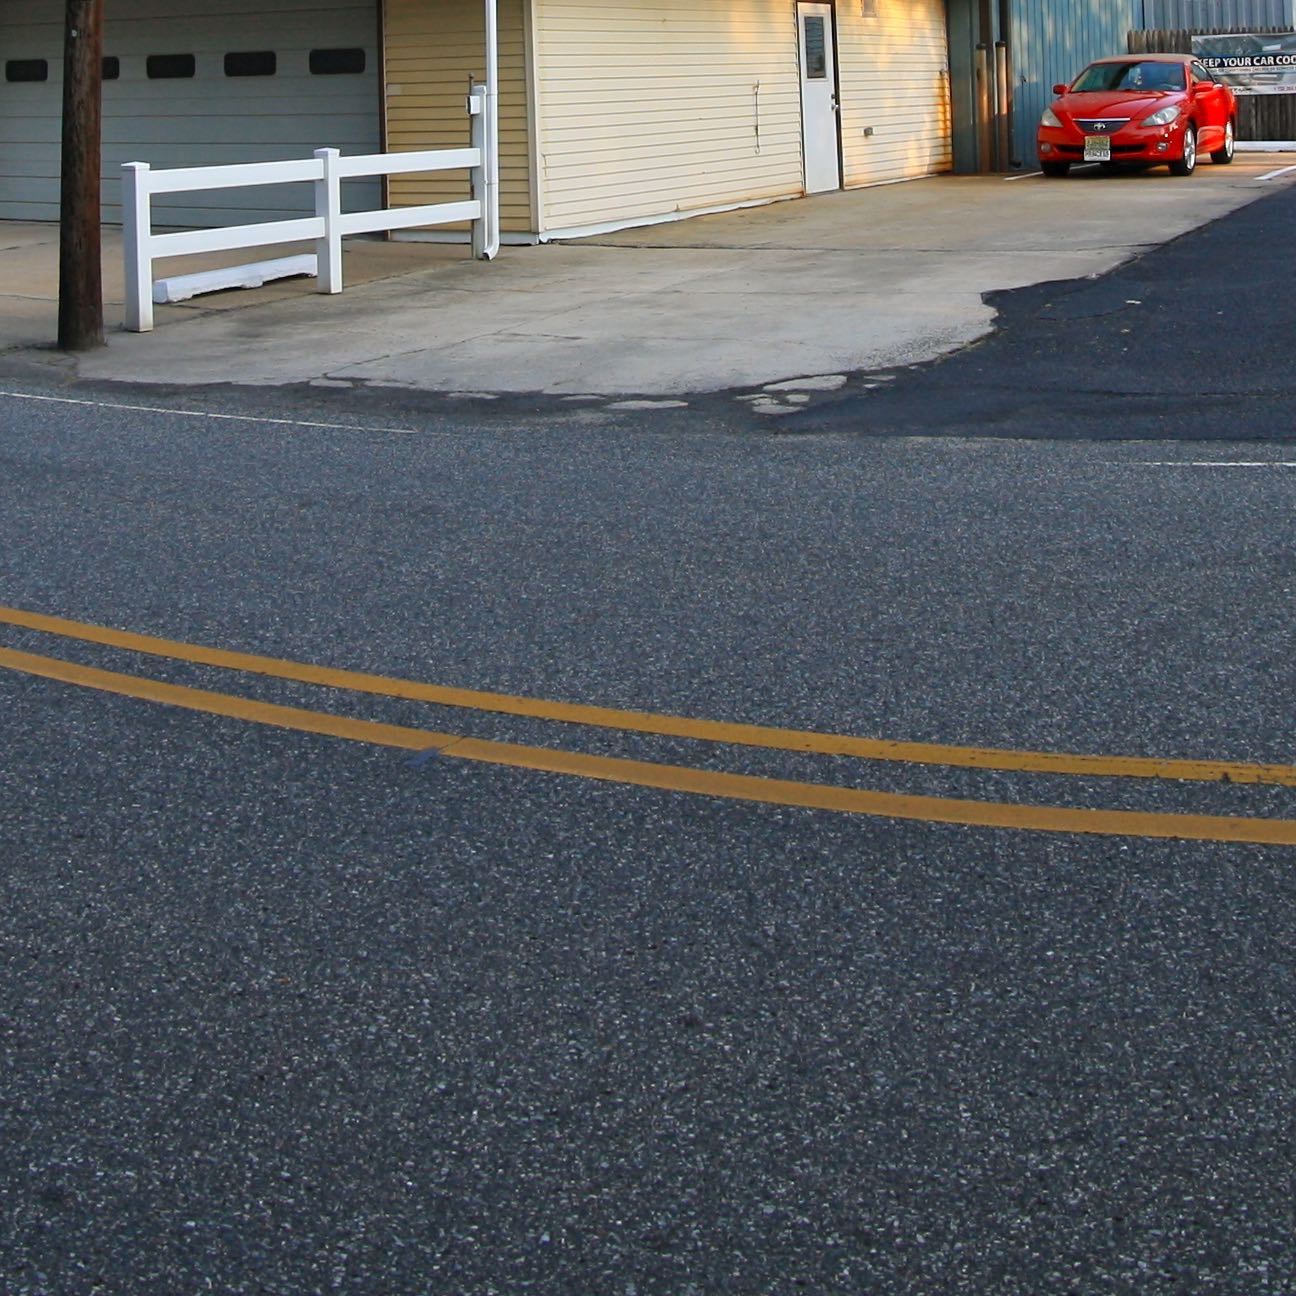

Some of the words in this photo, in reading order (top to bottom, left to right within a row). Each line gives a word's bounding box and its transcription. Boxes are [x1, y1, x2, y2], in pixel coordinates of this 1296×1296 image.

[1200, 58, 1221, 67] EEP
[1223, 57, 1251, 67] YOUR
[1253, 56, 1275, 65] CAR
